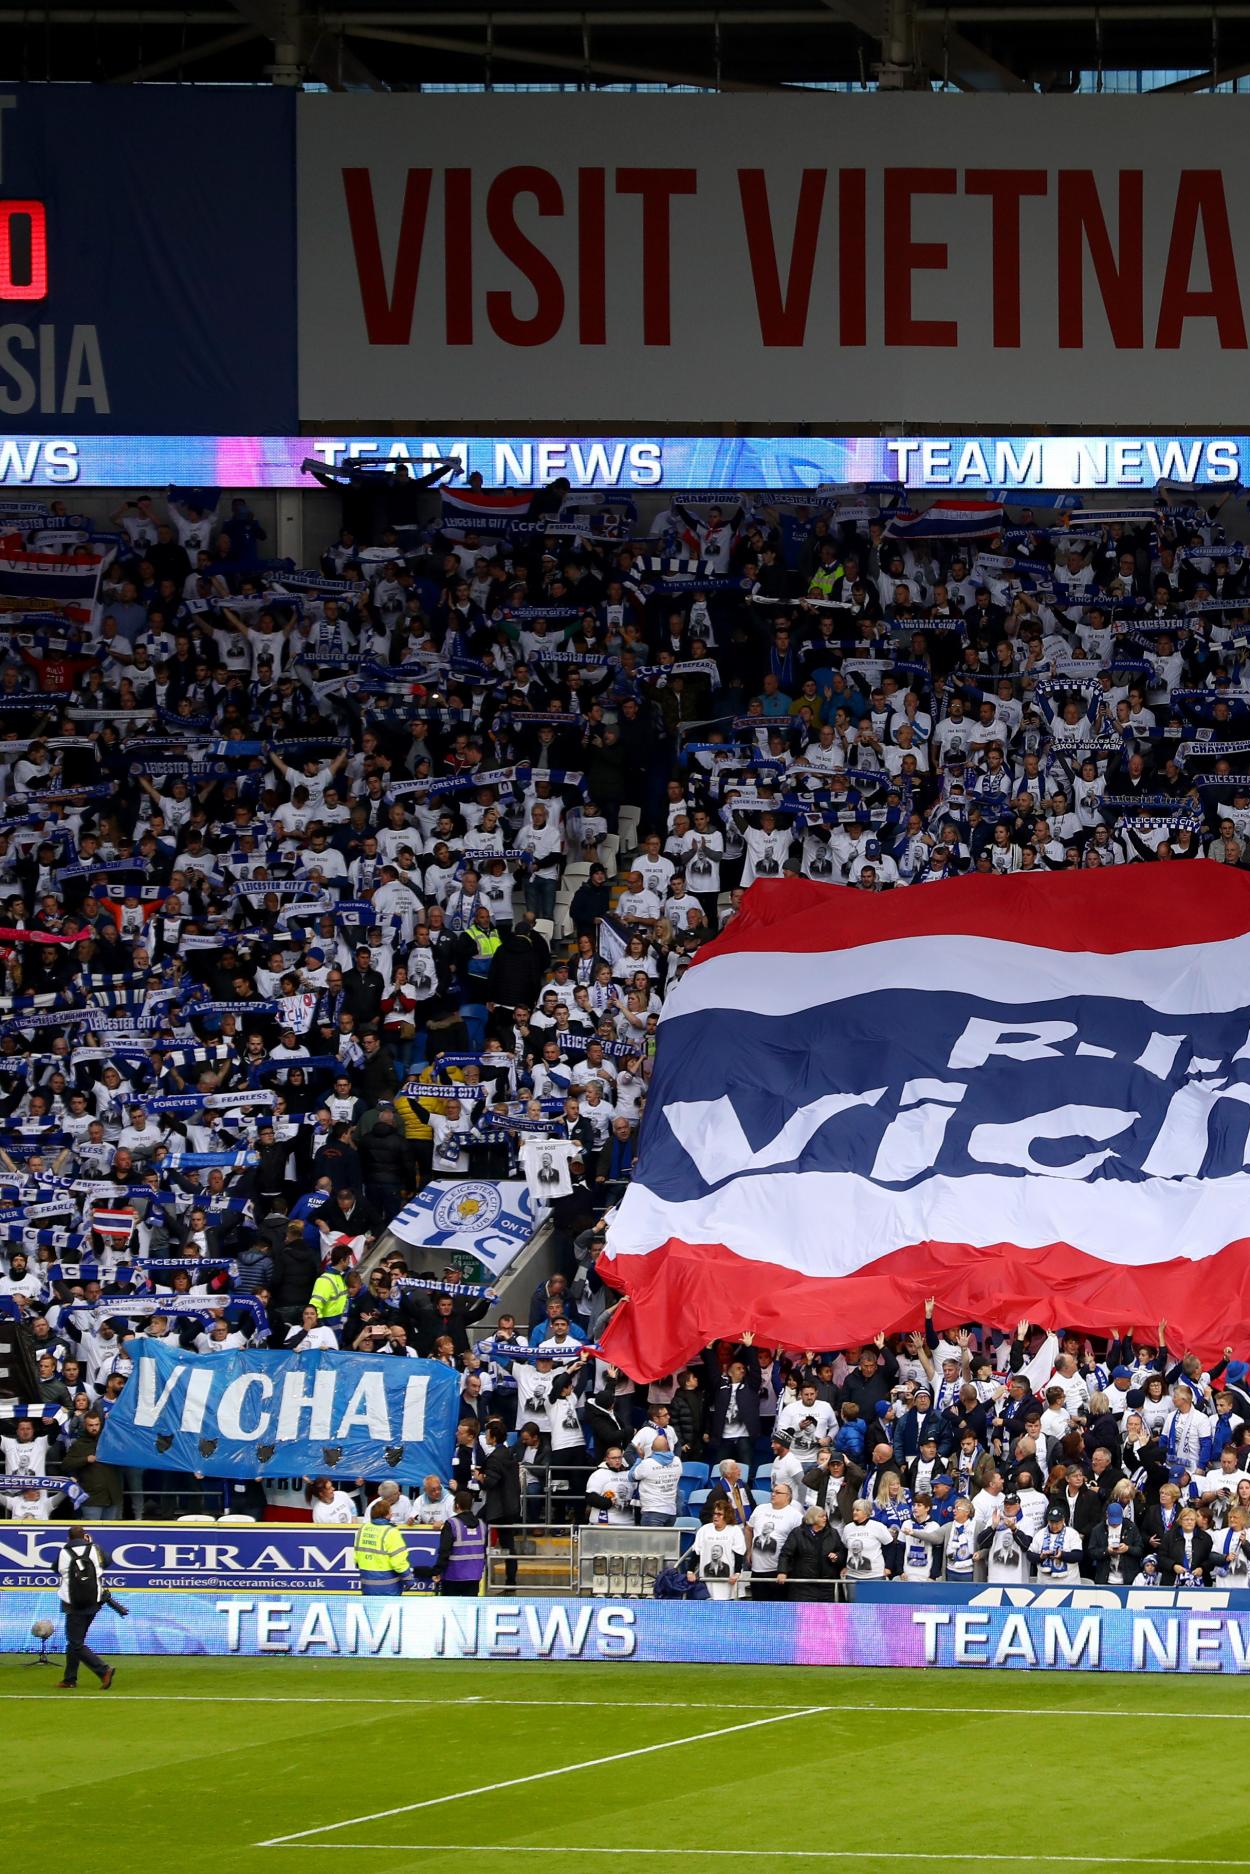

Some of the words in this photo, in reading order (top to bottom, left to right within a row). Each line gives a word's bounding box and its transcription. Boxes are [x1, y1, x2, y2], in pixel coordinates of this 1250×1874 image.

[341, 165, 697, 347] VISIT
[313, 441, 470, 485] TEAM
[493, 443, 664, 486] NEWS
[887, 440, 1045, 485] TEAM
[1072, 440, 1240, 485] NEWS
[675, 495, 740, 505] CHAMPIONS
[45, 516, 66, 528] CITY
[445, 517, 489, 529] LEICESTER
[511, 522, 544, 533] LCFC
[900, 622, 937, 631] FOOTBALL
[938, 622, 956, 630] CLUB
[1134, 618, 1183, 630] LEICESTER
[304, 652, 346, 662] LEICESTER
[347, 652, 364, 661] CITY
[541, 652, 582, 665] LEICESTER
[584, 654, 605, 665] CITY
[1039, 679, 1081, 688] LEICESTER
[274, 735, 352, 746] Leicester
[144, 761, 189, 774] LEICESTER
[191, 761, 211, 773] CITY
[1130, 817, 1177, 826] LEICESTER
[1179, 819, 1198, 828] CITY
[506, 849, 524, 858] CITY
[241, 881, 281, 891] LEICESTER
[284, 881, 304, 891] CITY
[194, 1000, 242, 1011] LEICESTER
[245, 1000, 273, 1011] CITY
[90, 1016, 134, 1031] LEICESTER
[136, 1016, 158, 1029] CITY
[408, 1084, 454, 1096] LEICESTER
[457, 1085, 479, 1097] CITY
[153, 1099, 198, 1109] FOREVER
[221, 1093, 268, 1103] FEARLESS
[34, 1173, 71, 1187] LCFC
[501, 1219, 514, 1230] ON
[197, 1257, 229, 1266] CITY
[397, 1277, 442, 1291] LEICESTER
[444, 1282, 465, 1294] CITY
[467, 1284, 480, 1296] FC
[498, 1343, 553, 1355] LEICESTER
[554, 1344, 576, 1354] CITY
[133, 1355, 430, 1442] VICHAI
[41, 1479, 66, 1488] CITY
[148, 1576, 325, 1589] enquiries@ncceramics.co.uk
[216, 1600, 402, 1655] TEAM
[434, 1605, 637, 1658] NEWS
[911, 1611, 1101, 1668] TEAM
